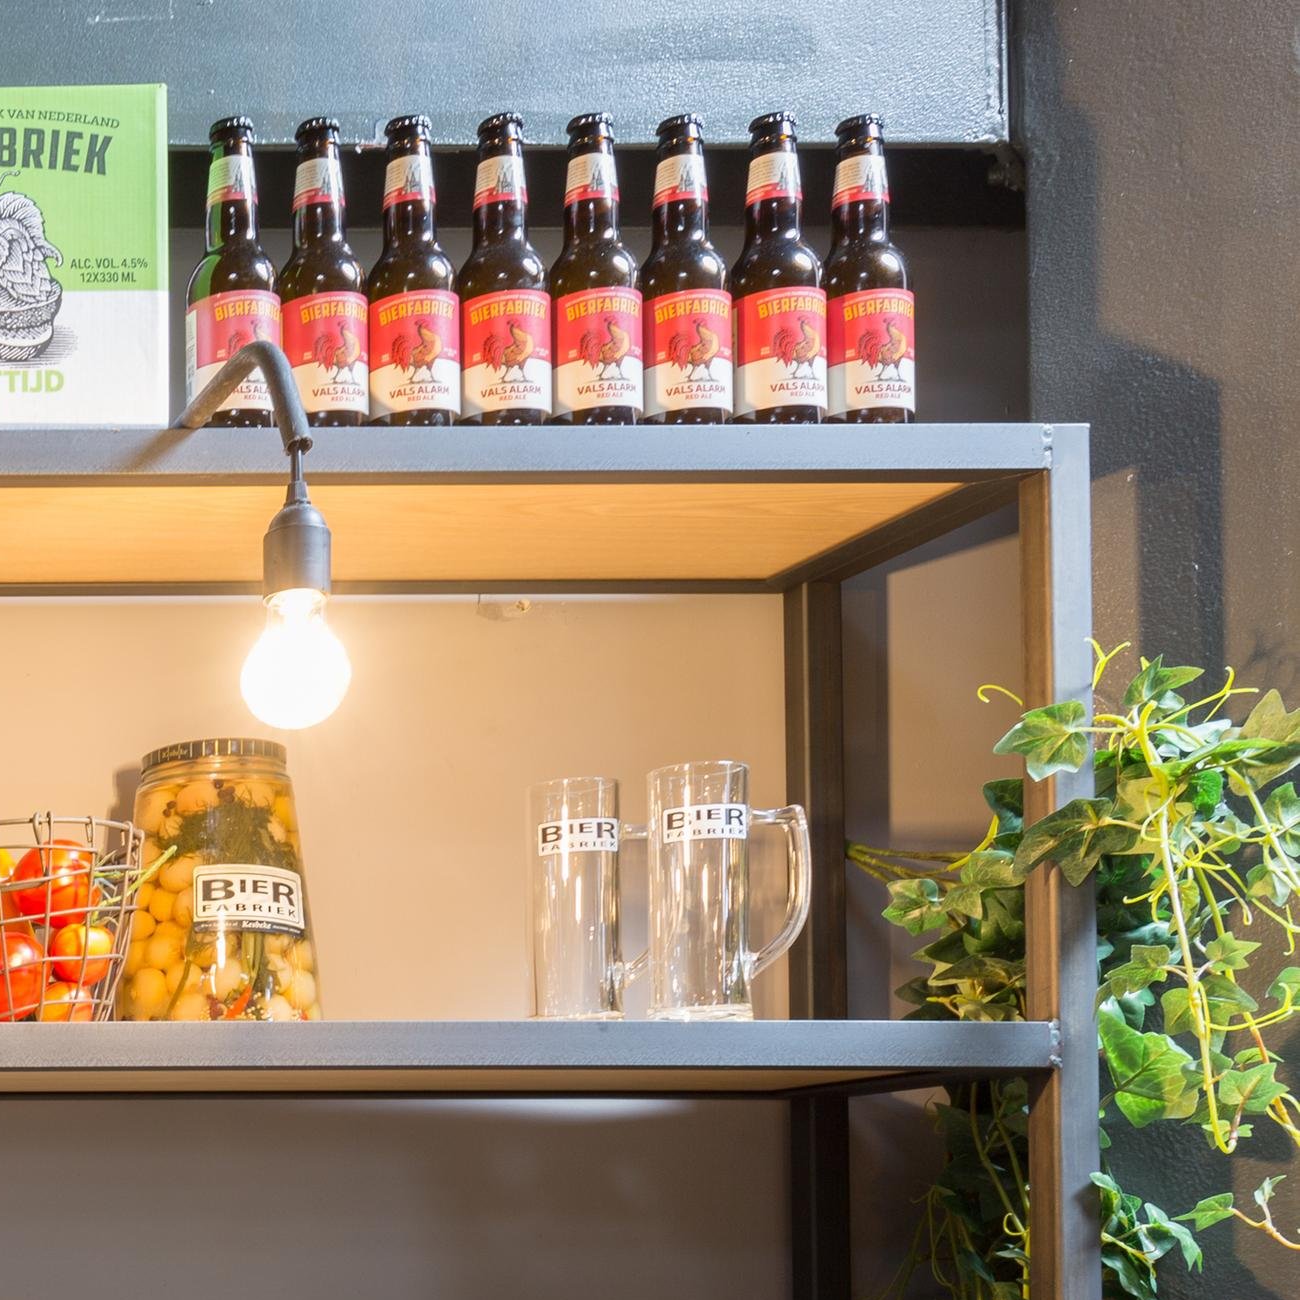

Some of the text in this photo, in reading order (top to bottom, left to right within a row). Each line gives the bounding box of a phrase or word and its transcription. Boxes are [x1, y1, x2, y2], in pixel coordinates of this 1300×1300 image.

[6, 109, 35, 119] VAN
[38, 110, 120, 129] NEDERLAND
[120, 258, 148, 268] 4.5%
[80, 272, 137, 283] 12X330 ML
[470, 300, 546, 326] BIERFABRIEK
[232, 384, 251, 394] ALS
[312, 386, 338, 398] VALS
[389, 384, 450, 399] VALS ALARM
[480, 384, 542, 398] VALS ALARM
[577, 382, 636, 396] VALS ALARM
[666, 382, 726, 397] VALS ALARM
[770, 382, 798, 392] VALS
[855, 384, 884, 395] VALS
[667, 808, 744, 830] BIER
[541, 822, 616, 844] BIER
[202, 879, 295, 907] BIER
[202, 904, 297, 918] FABRIEK
